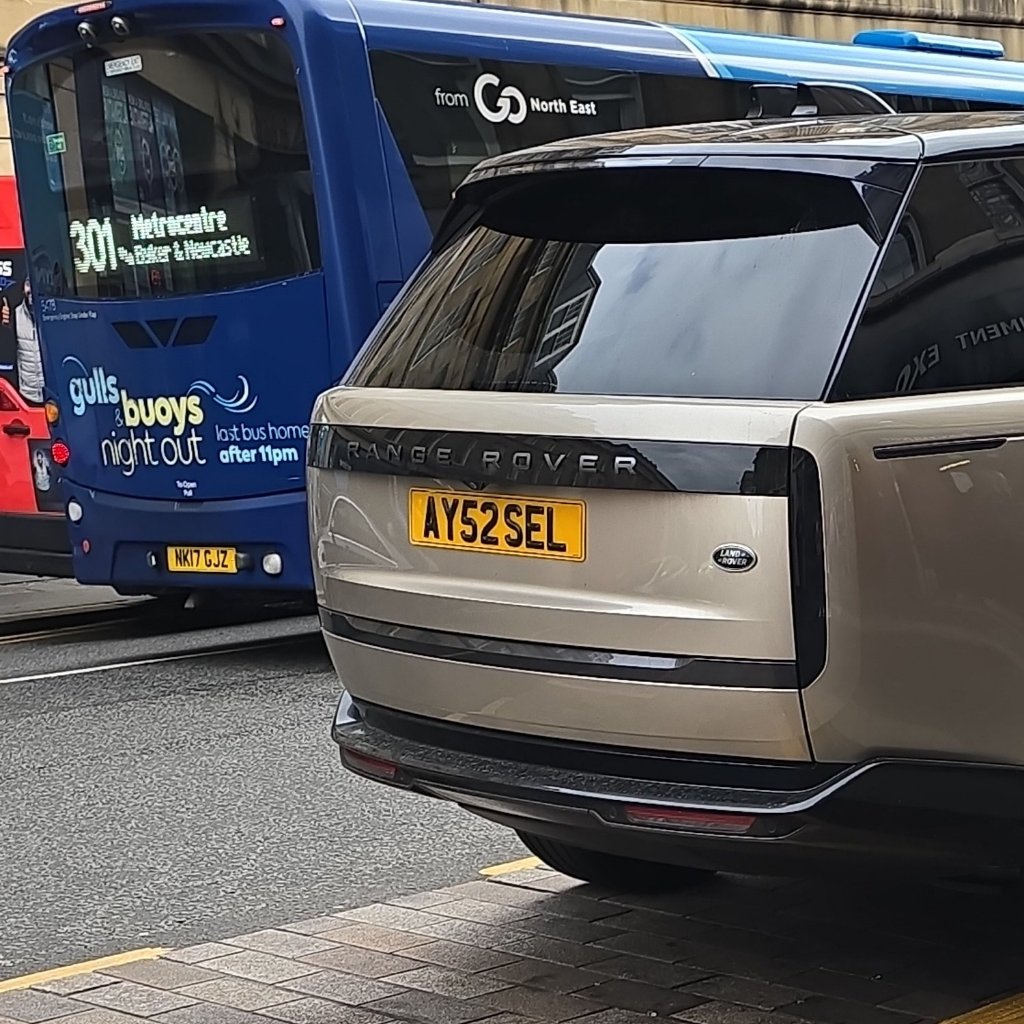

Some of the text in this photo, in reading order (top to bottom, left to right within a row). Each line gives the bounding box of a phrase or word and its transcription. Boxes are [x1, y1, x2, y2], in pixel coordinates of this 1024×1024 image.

[434, 88, 469, 107] from
[530, 97, 567, 113] North
[569, 100, 597, 115] East
[69, 206, 228, 273] 301 Metrocentre
[183, 235, 251, 260] Newcastle
[69, 367, 119, 416] gulls
[114, 390, 204, 436] & buoys
[215, 422, 311, 441] last bus home
[101, 429, 206, 476] night out
[220, 444, 299, 466] after 11pm
[347, 441, 637, 475] RANGE ROVER
[423, 495, 567, 553] AY52SEL
[175, 549, 229, 569] NK17 GJZ
[720, 549, 741, 558] LAND
[721, 557, 747, 566] ROVER
